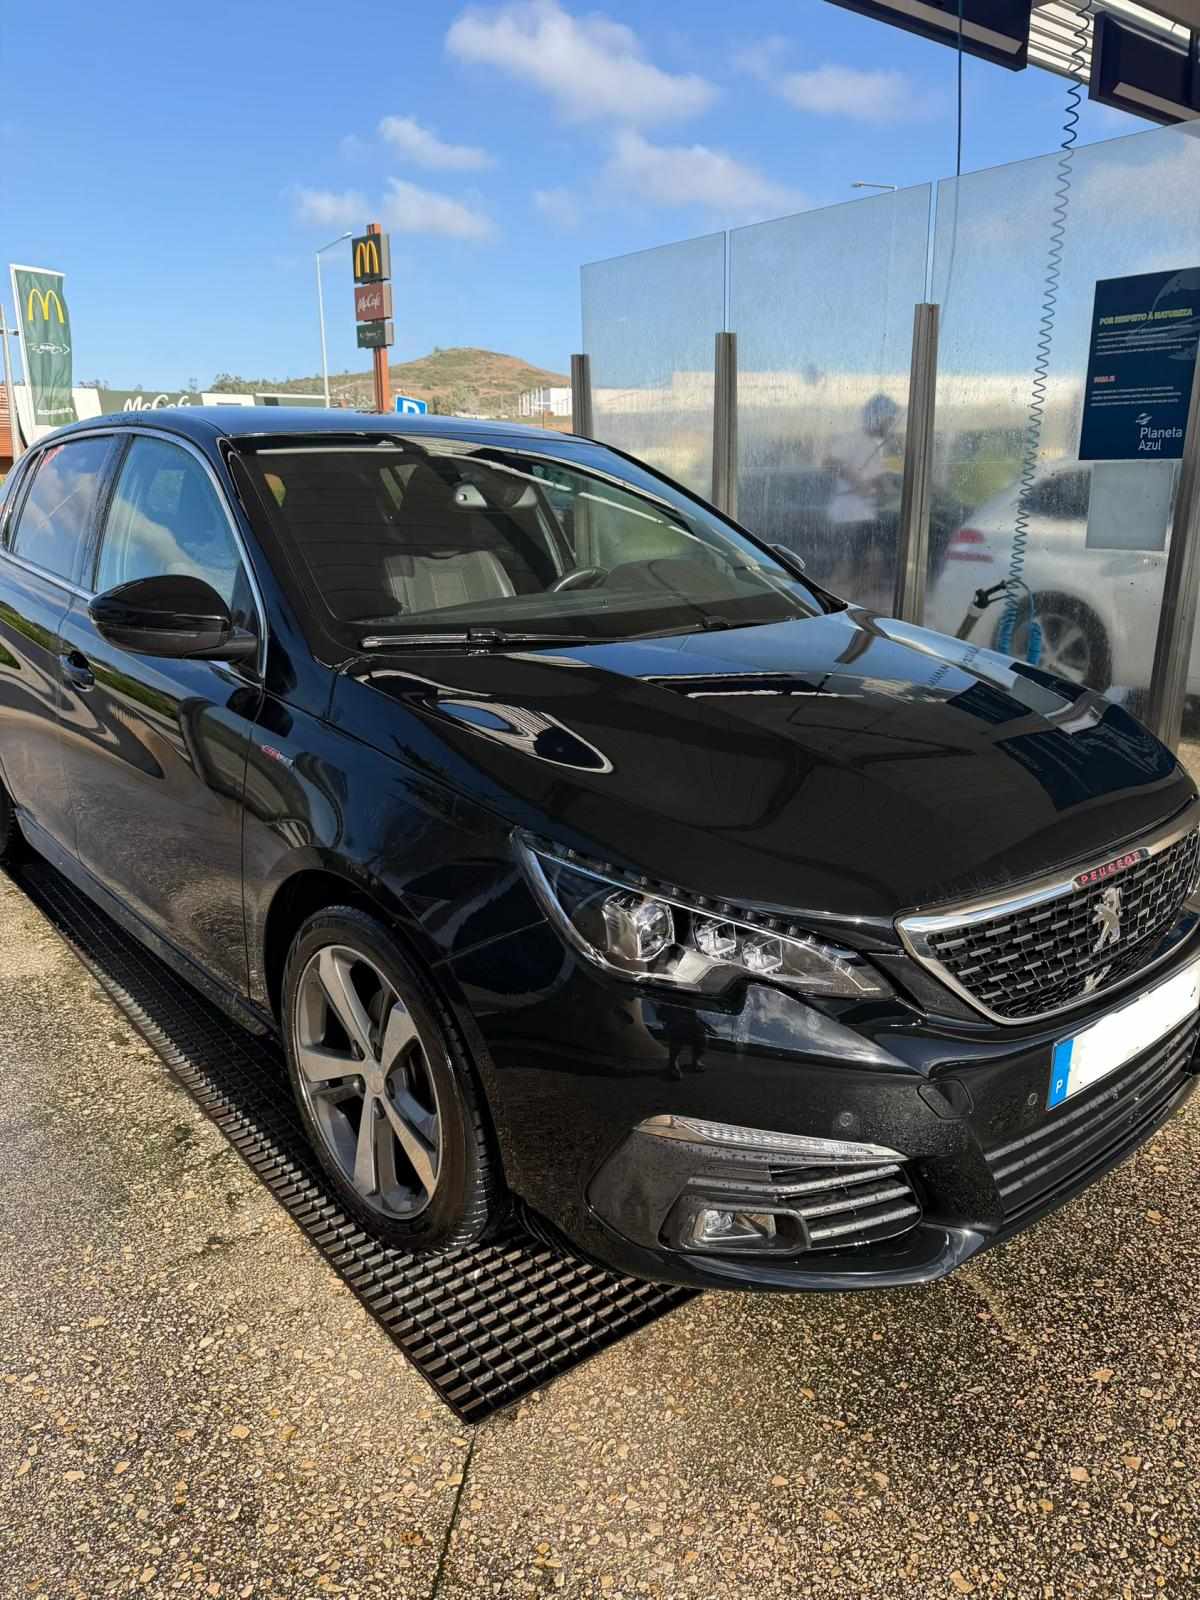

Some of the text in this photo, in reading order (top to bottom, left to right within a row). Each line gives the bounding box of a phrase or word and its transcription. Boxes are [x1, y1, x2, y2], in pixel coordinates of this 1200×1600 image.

[1140, 426, 1183, 439] Planeta
[1138, 439, 1162, 451] Azul
[1080, 851, 1141, 885] PEUGEOT
[1056, 1079, 1063, 1094] P
